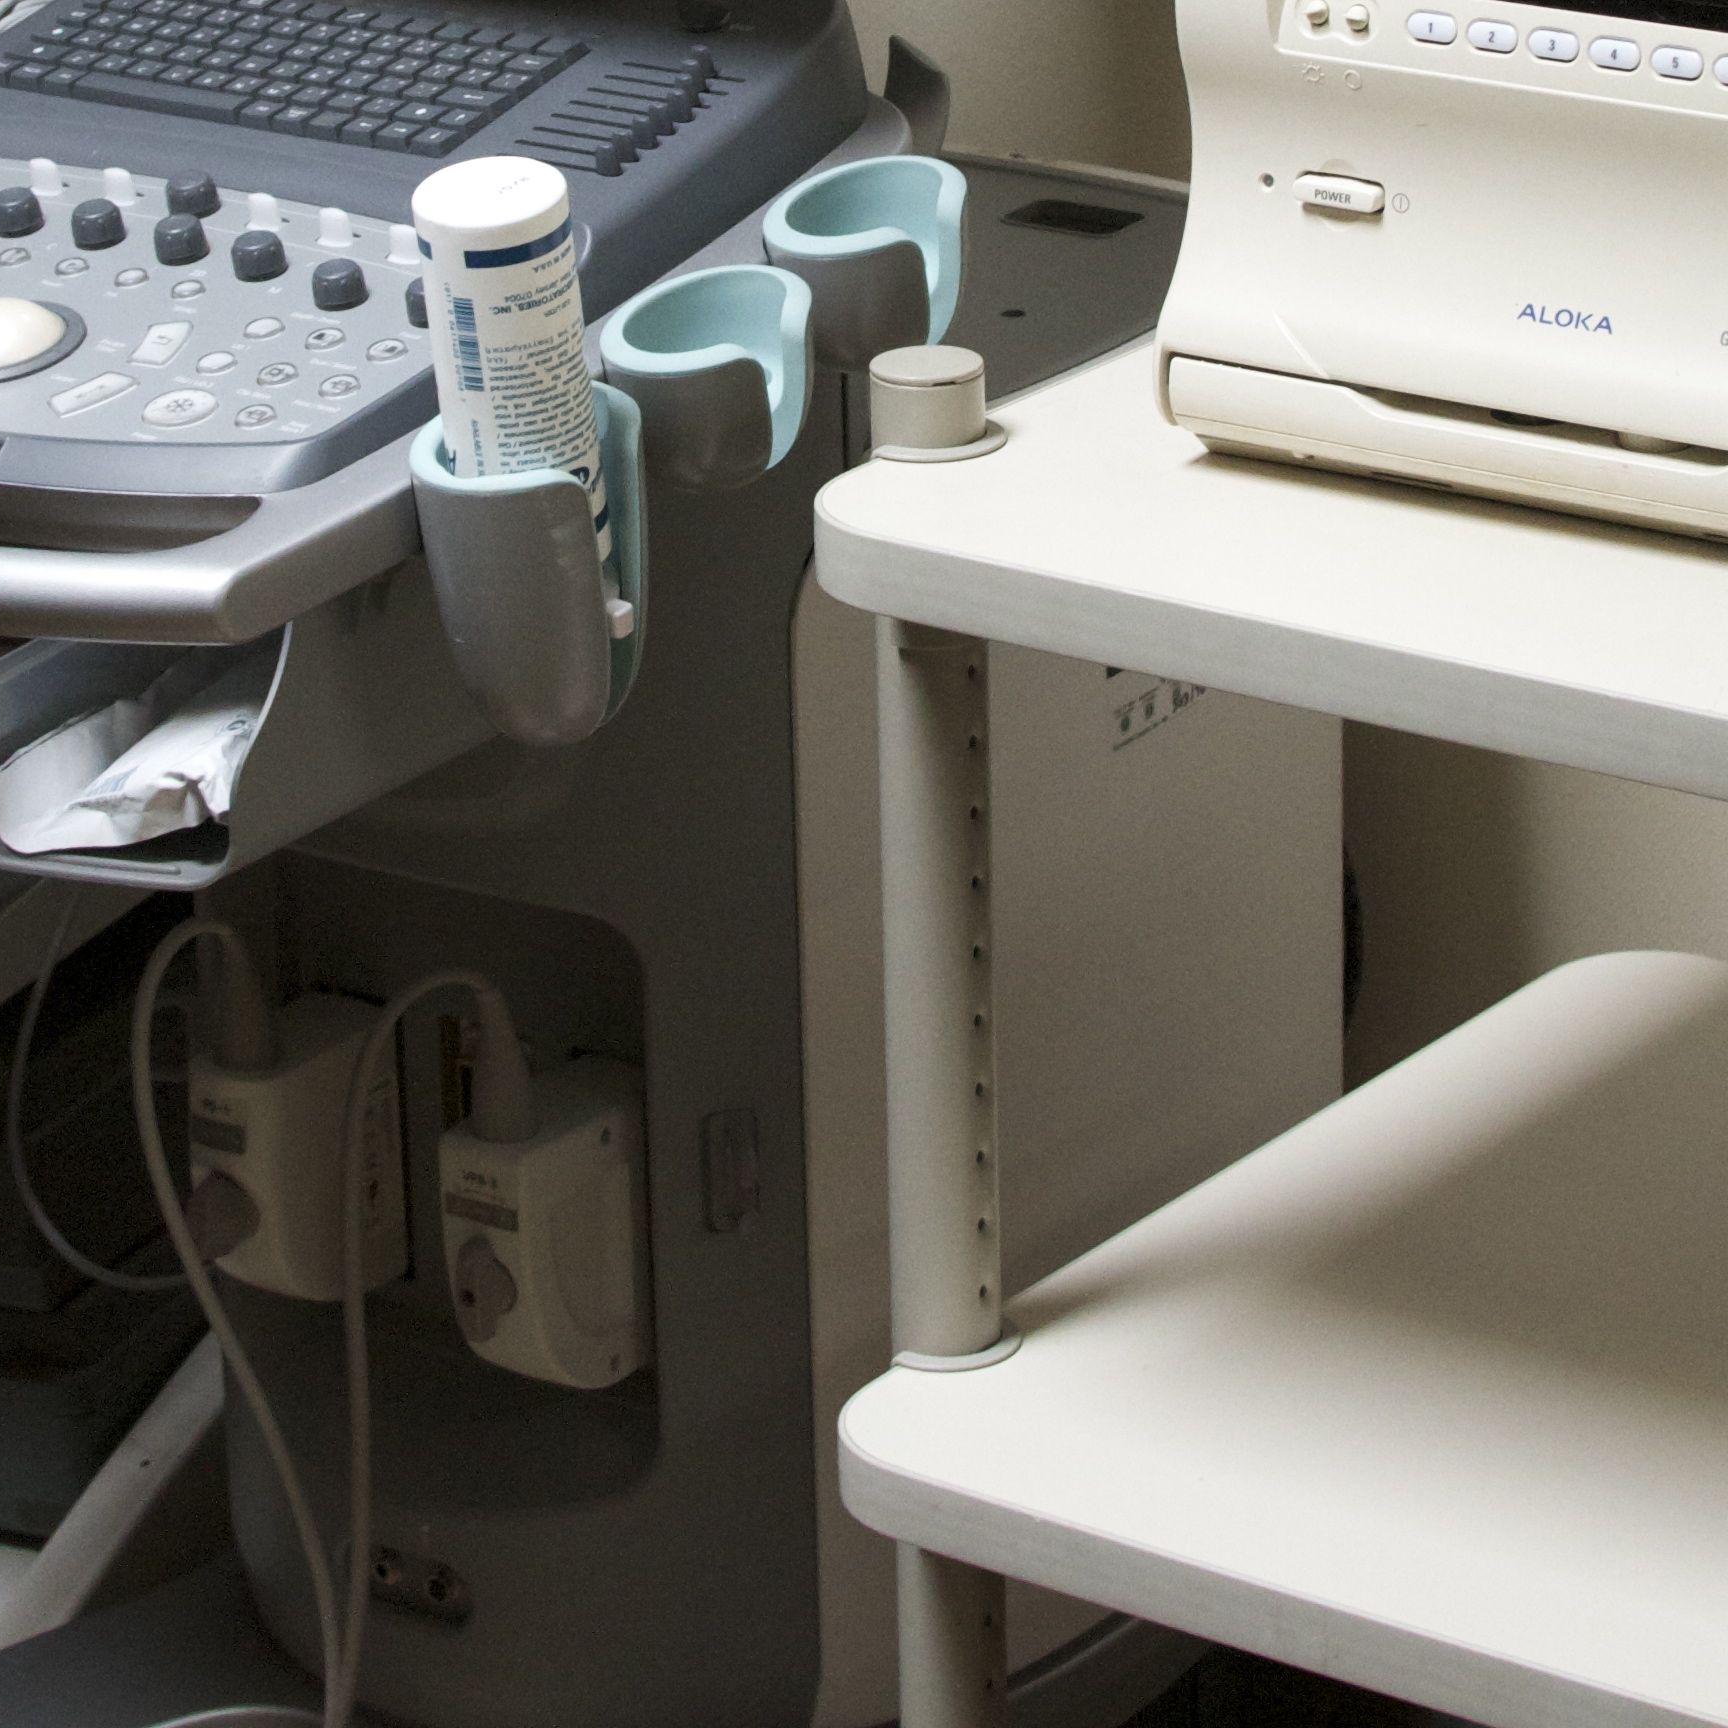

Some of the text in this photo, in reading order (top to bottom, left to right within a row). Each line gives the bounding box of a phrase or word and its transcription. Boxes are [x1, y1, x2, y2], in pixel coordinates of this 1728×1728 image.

[1428, 22, 1434, 34] 1
[1488, 31, 1496, 44] 2
[1548, 39, 1556, 52] 3
[1610, 48, 1618, 61] 4
[1671, 57, 1680, 70] 5
[1314, 189, 1352, 205] POWER
[1516, 302, 1614, 335] ALOKA
